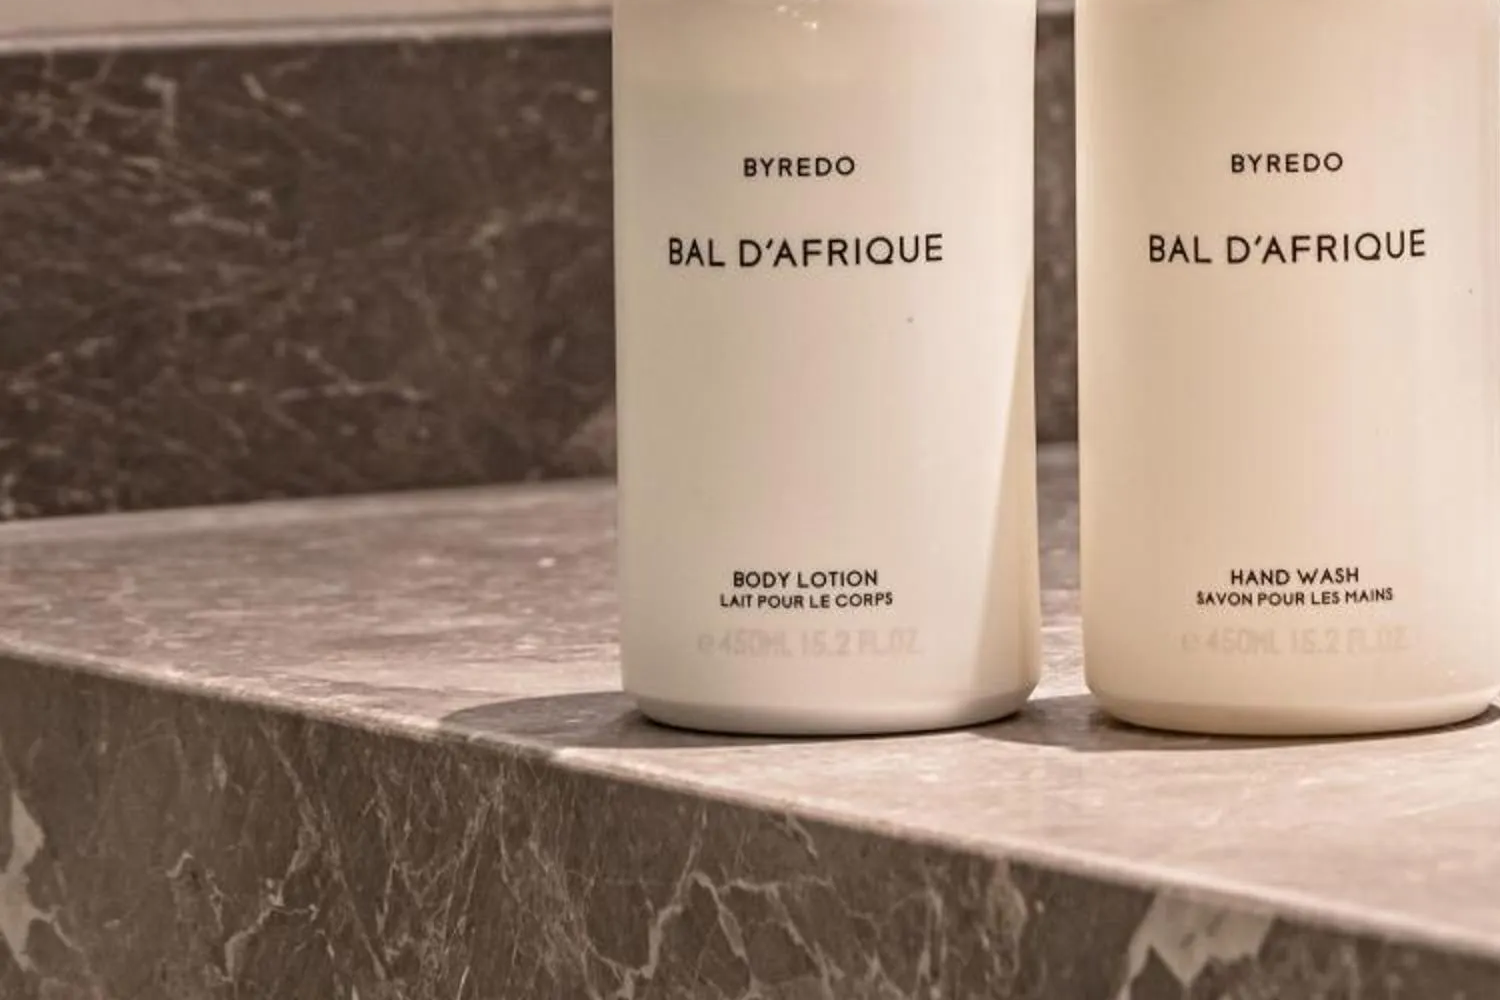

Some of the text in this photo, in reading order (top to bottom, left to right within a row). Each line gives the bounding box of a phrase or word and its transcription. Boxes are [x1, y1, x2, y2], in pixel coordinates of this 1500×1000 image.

[743, 155, 855, 178] BYREDO
[1230, 151, 1344, 174] BYREDO
[668, 233, 943, 268] BAL D'AFRIQUE
[1148, 228, 1426, 265] BAL D'AFRIQUE
[732, 569, 879, 589] BODY LOTION
[1230, 567, 1360, 587] HAND WASH
[719, 591, 894, 609] LAIT POUR LE CORPS
[1196, 587, 1394, 607] SAVON POUR LES MAINS
